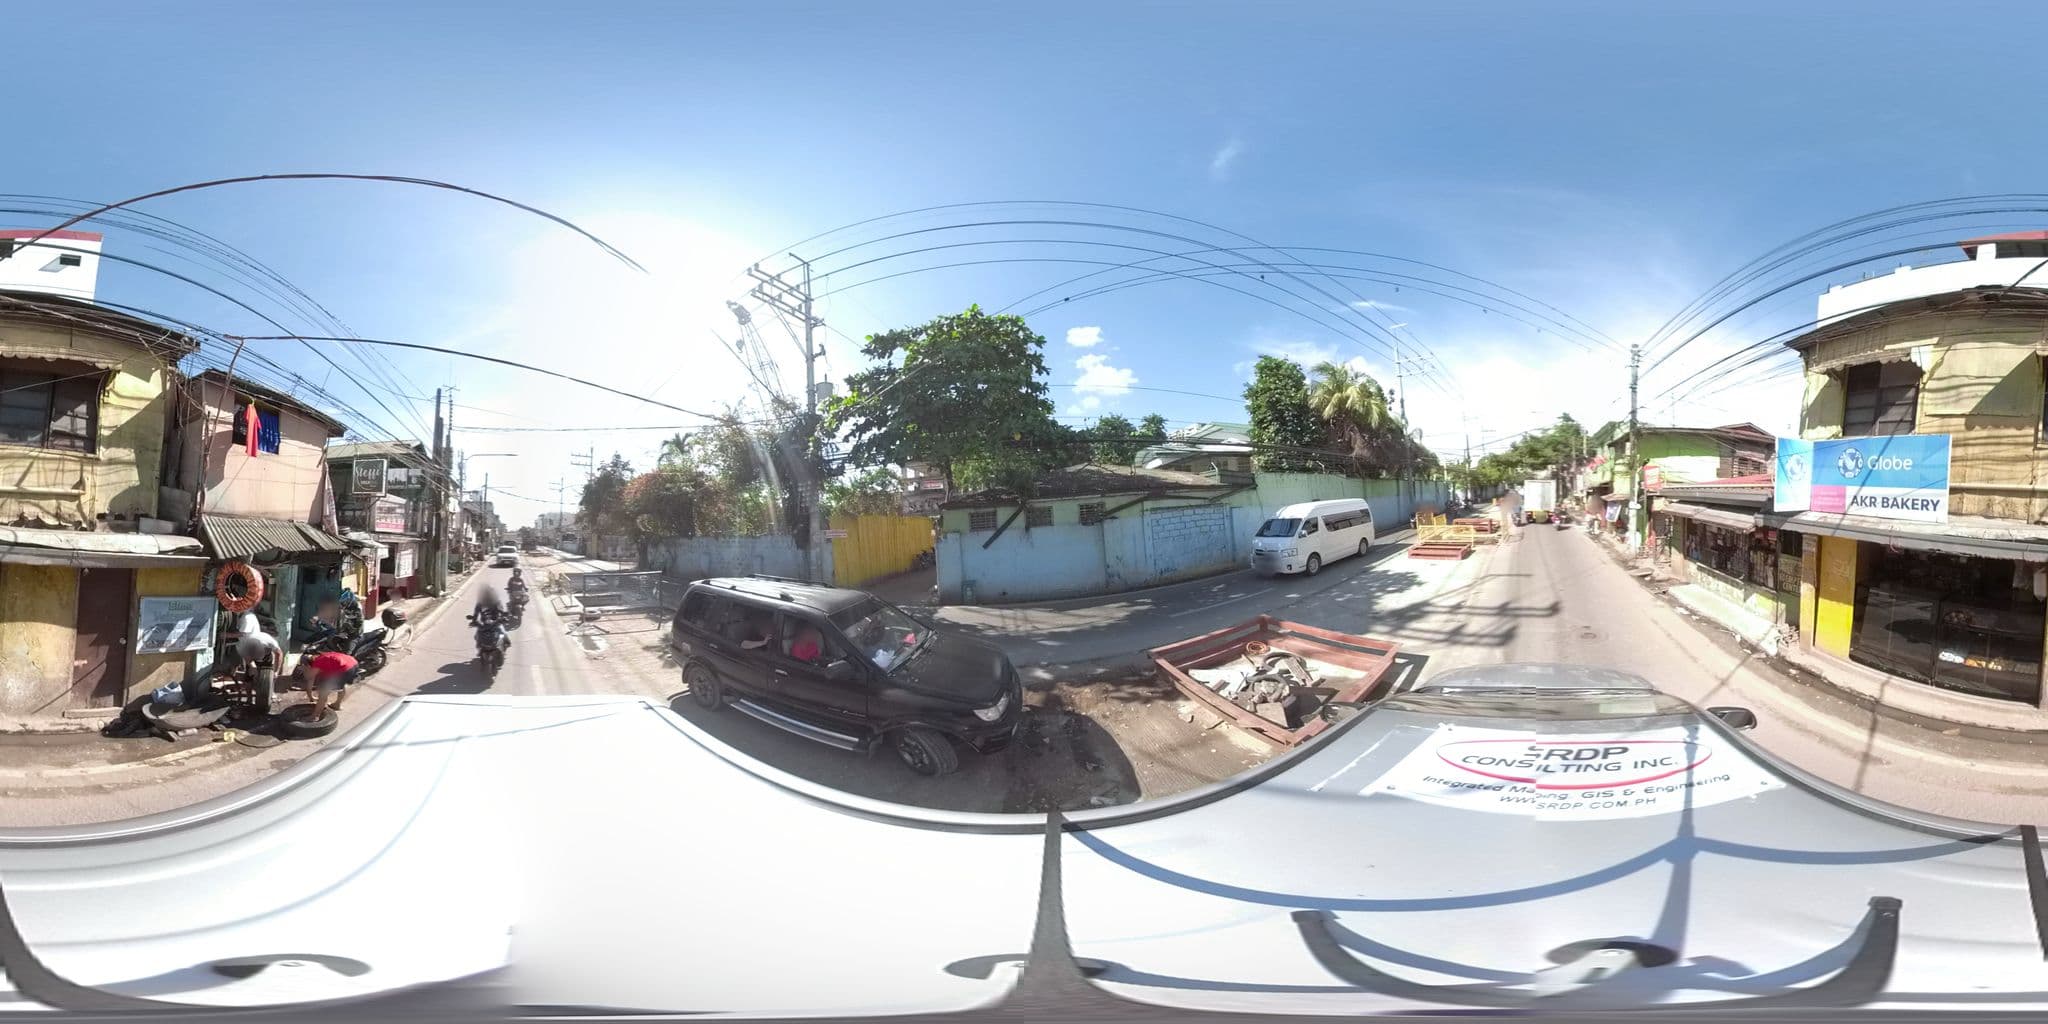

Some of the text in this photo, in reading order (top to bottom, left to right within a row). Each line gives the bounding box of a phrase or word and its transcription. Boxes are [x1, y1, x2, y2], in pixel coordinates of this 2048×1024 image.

[1867, 455, 1913, 471] Globe
[1850, 495, 1878, 508] AKR
[1881, 498, 1940, 512] BAKERY
[1633, 756, 1678, 769] INC.
[1422, 775, 1506, 792] Integrated
[1581, 790, 1614, 799] GIS
[1622, 788, 1636, 796] &
[1644, 774, 1731, 793] Engineering
